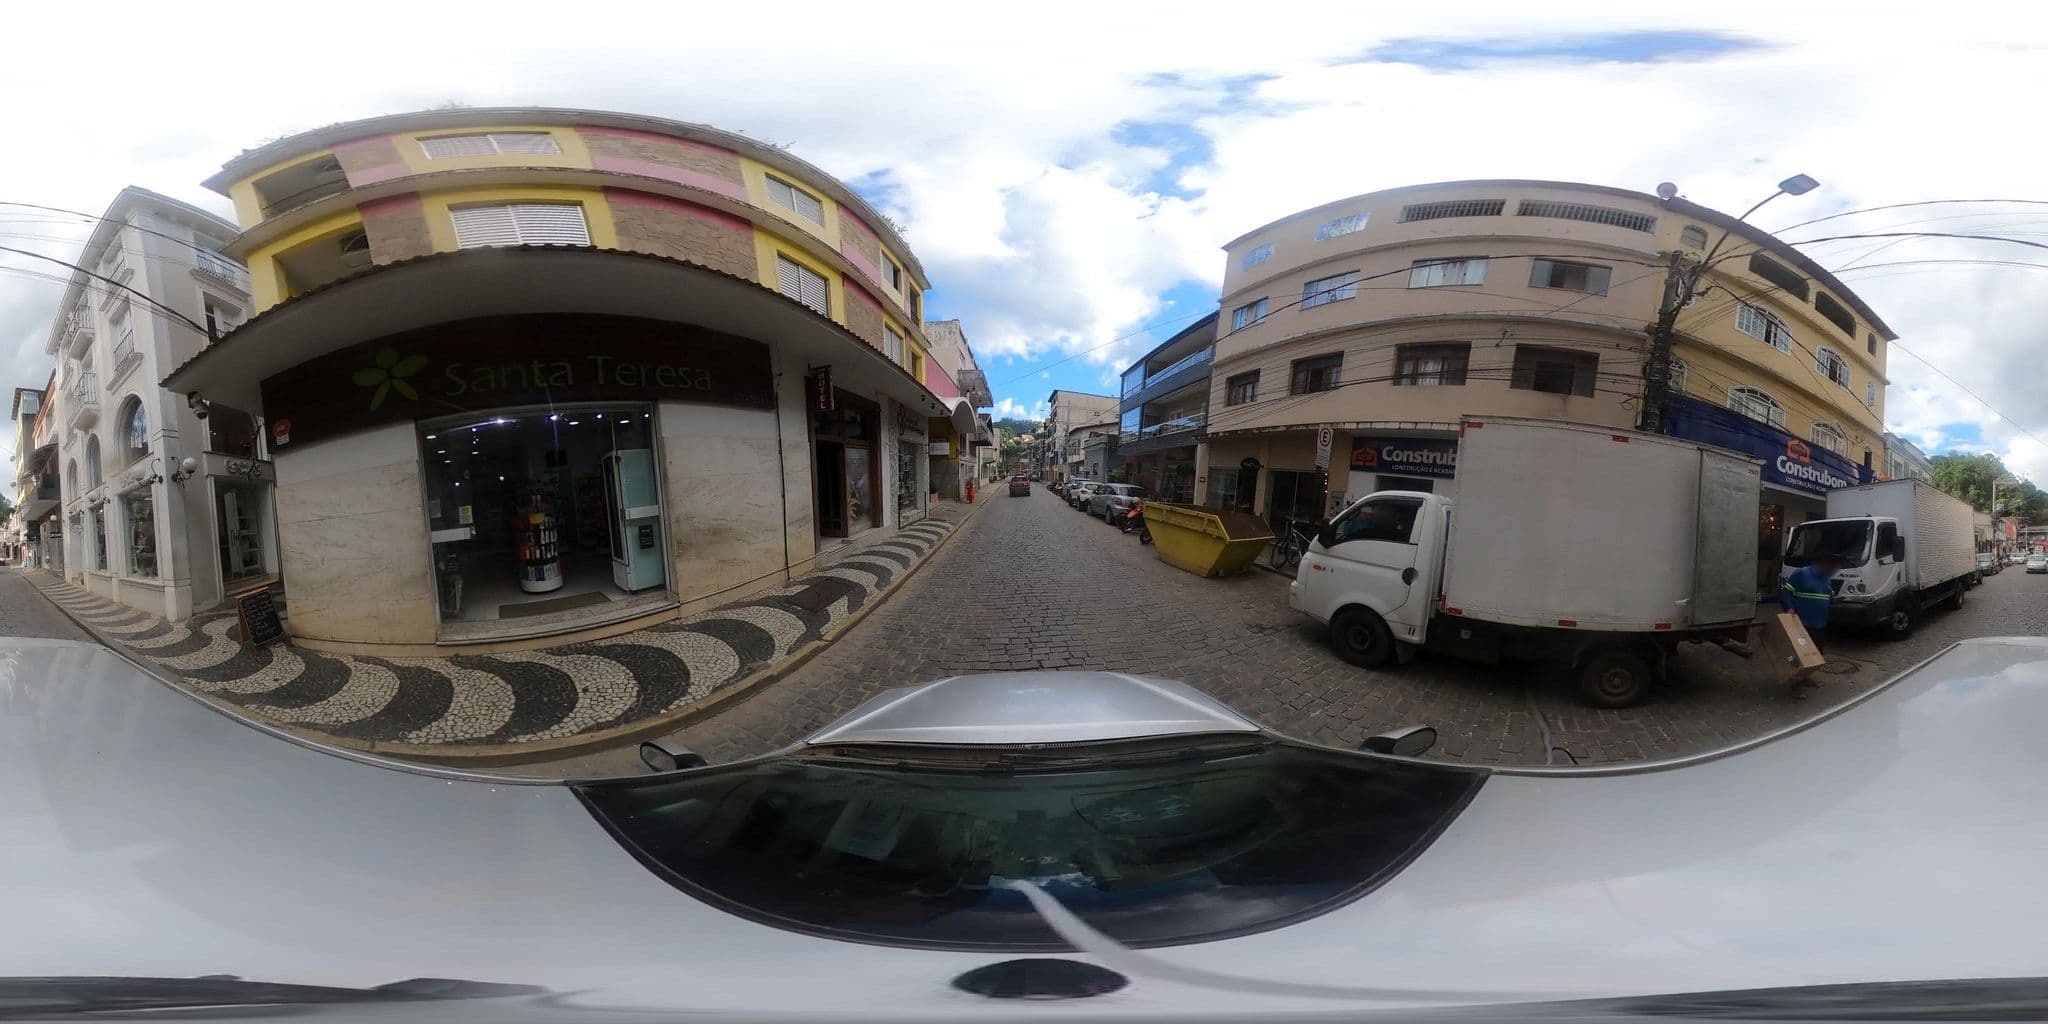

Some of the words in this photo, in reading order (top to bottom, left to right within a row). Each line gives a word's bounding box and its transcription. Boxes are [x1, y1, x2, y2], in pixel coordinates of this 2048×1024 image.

[445, 359, 573, 396] Santa
[587, 355, 712, 391] Teresa
[818, 371, 826, 409] HOTEL
[1322, 430, 1329, 443] E
[1776, 455, 1847, 488] Construbom
